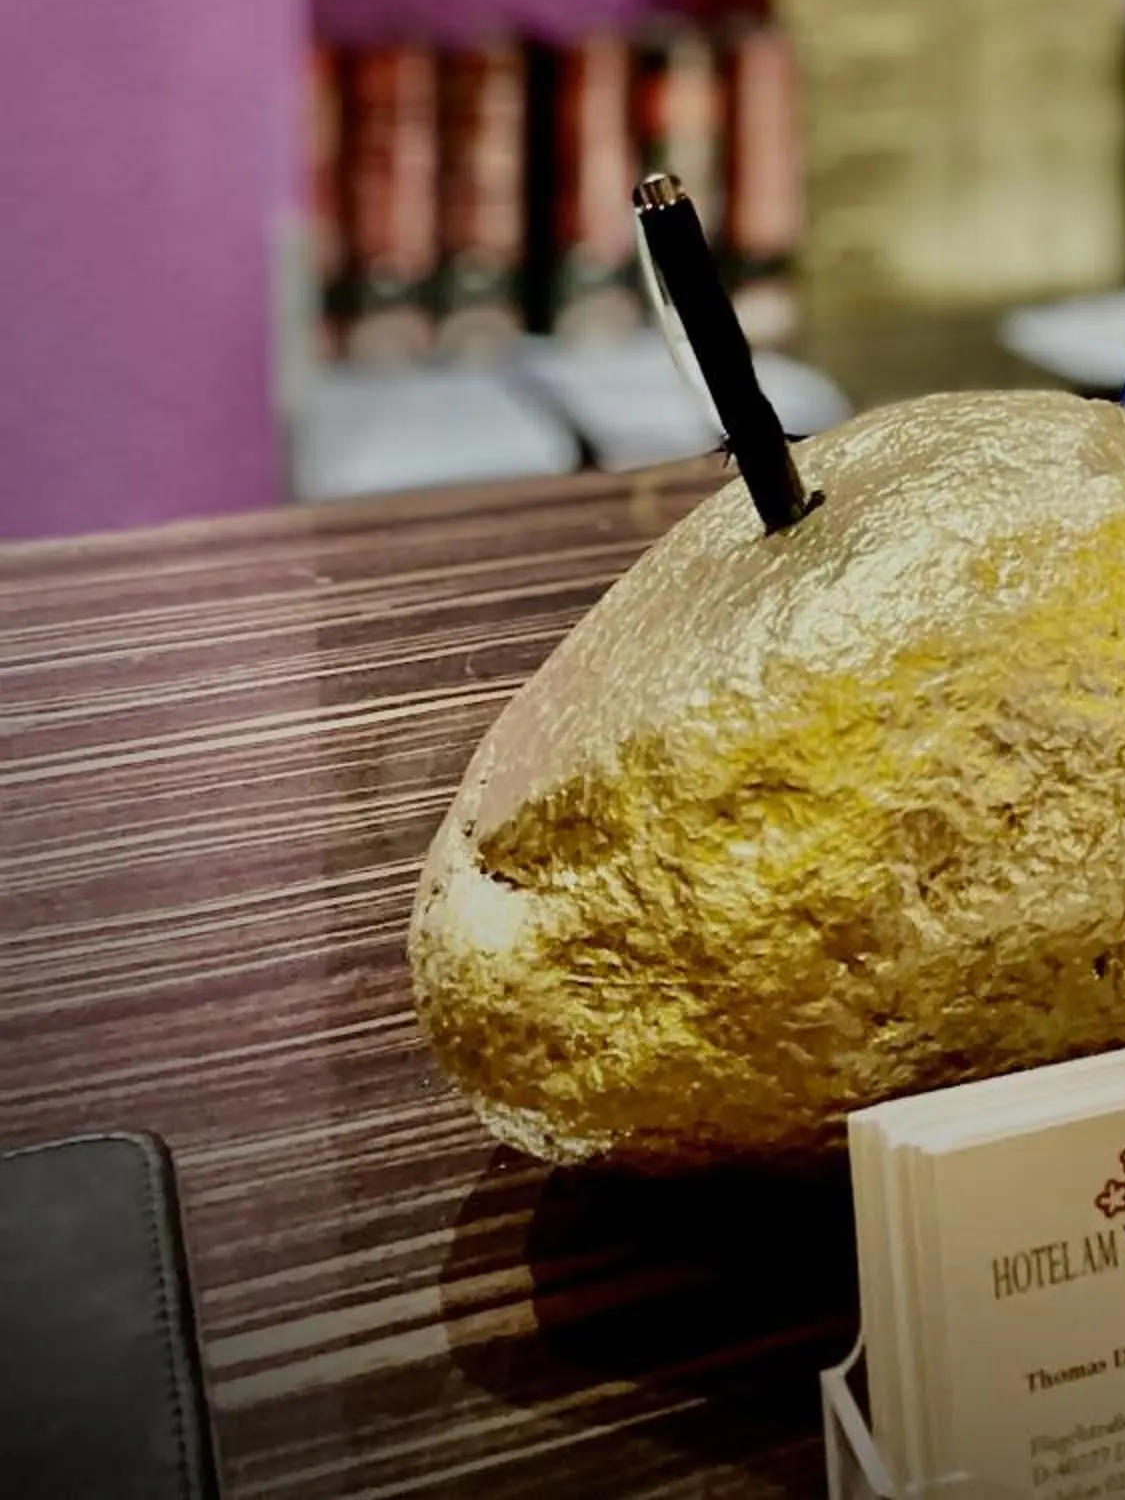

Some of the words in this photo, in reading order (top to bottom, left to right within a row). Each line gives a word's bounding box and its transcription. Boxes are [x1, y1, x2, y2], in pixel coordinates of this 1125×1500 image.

[991, 1240, 1077, 1300] HOTEL
[1083, 1229, 1119, 1277] AM
[1024, 1359, 1107, 1394] Thomas
